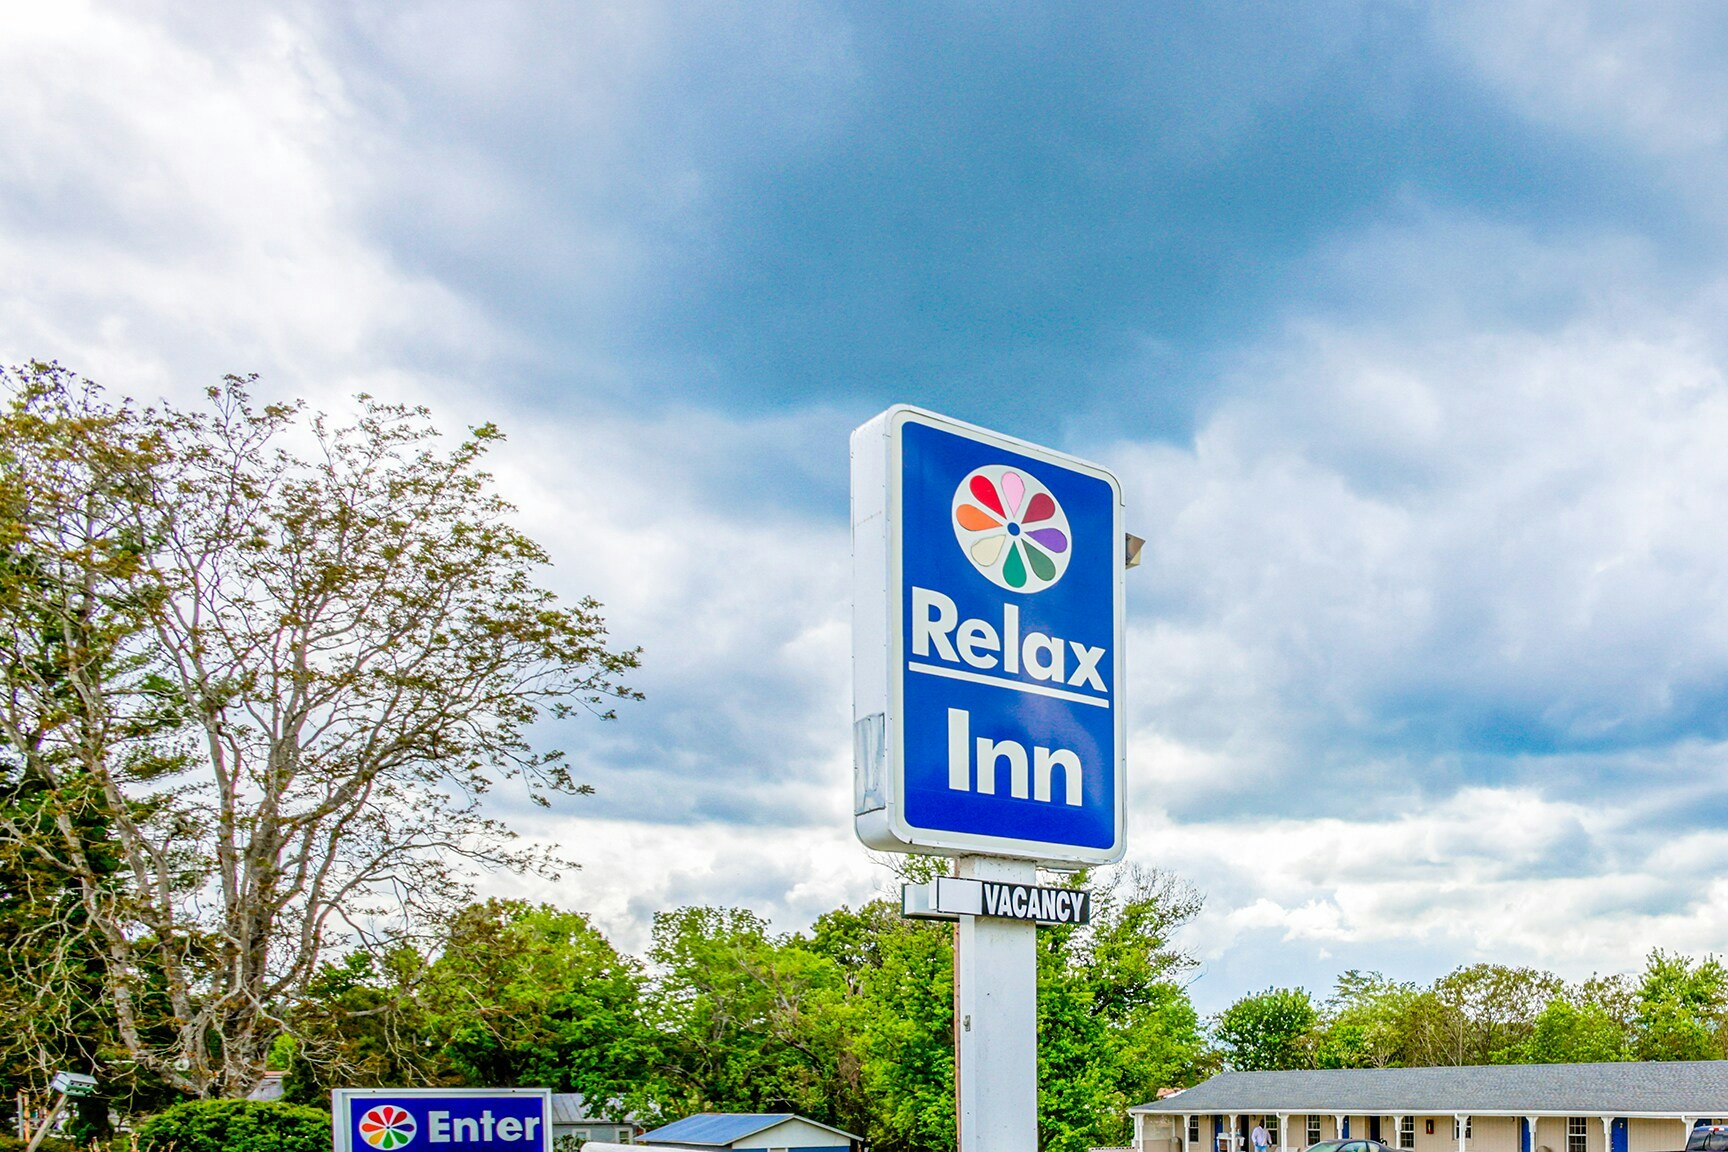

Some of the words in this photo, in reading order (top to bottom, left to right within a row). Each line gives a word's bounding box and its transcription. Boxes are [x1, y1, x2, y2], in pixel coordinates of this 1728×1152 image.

[911, 586, 1108, 693] Relax
[947, 707, 1083, 807] Inn
[983, 883, 1085, 922] VACANCY
[428, 1110, 540, 1143] Enter
